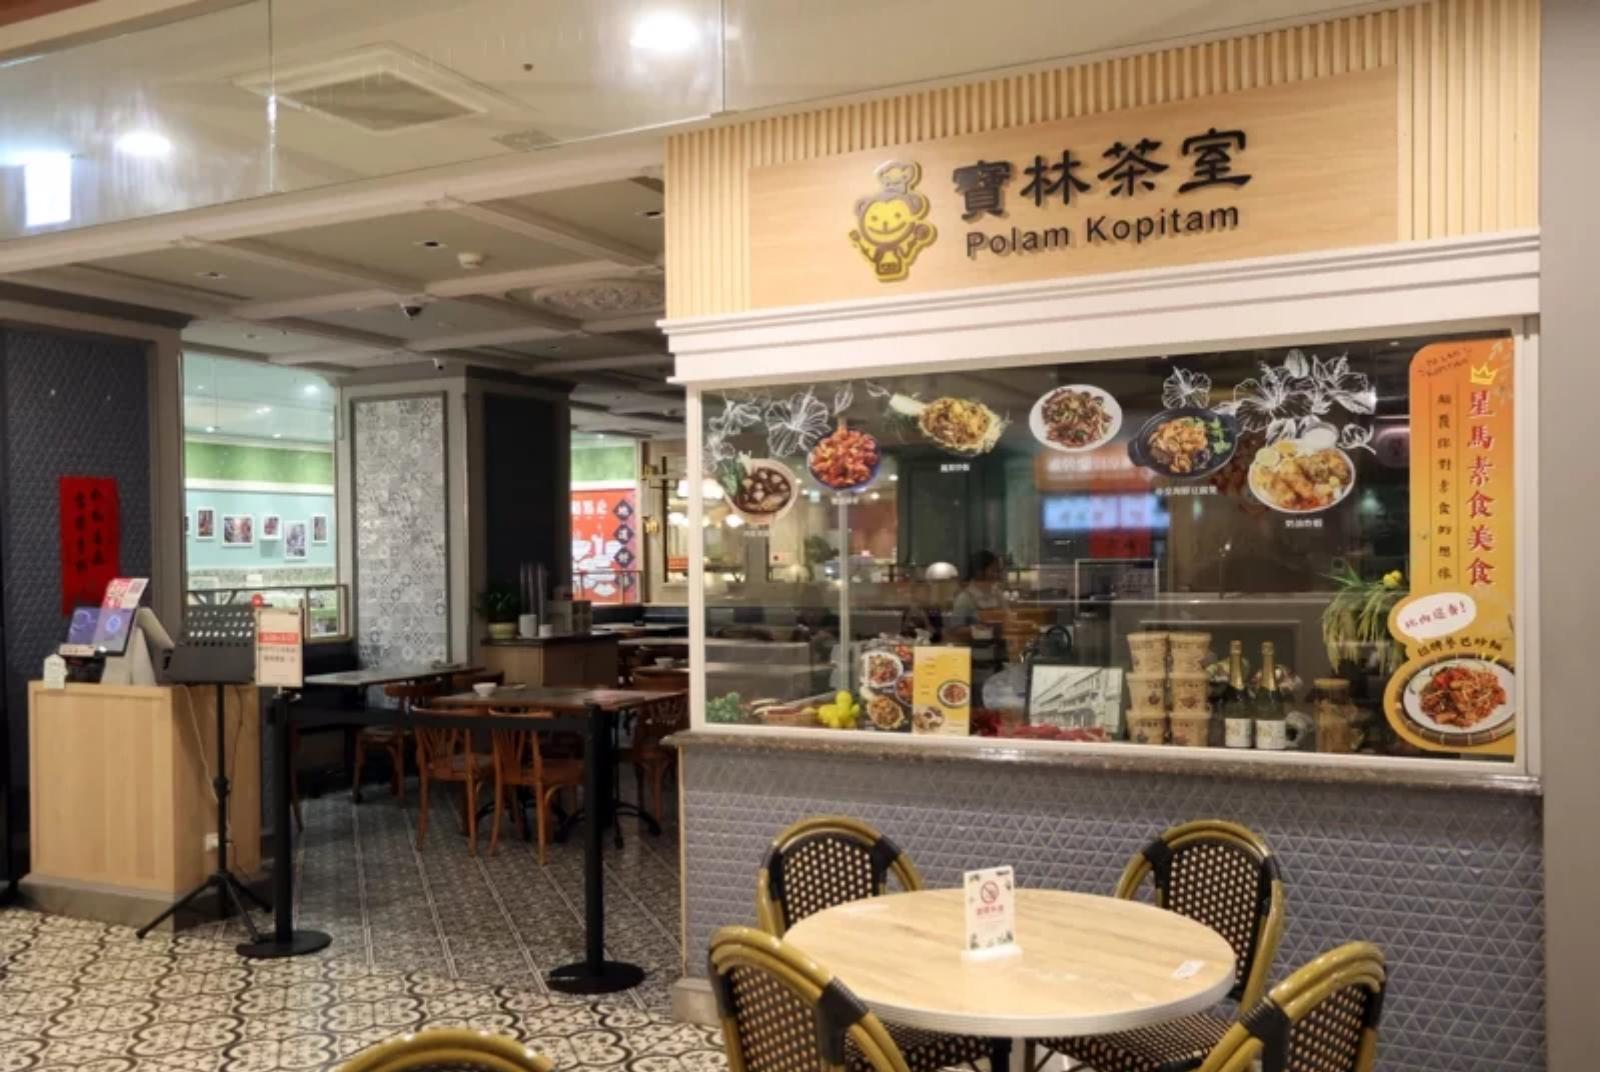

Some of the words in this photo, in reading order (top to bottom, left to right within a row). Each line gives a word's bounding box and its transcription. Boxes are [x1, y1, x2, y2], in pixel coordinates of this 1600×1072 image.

[952, 127, 1253, 222] 寶林茶室
[966, 228, 1070, 258] Polam
[1086, 204, 1240, 244] Kopitam
[1466, 388, 1496, 586] 星馬素食美食
